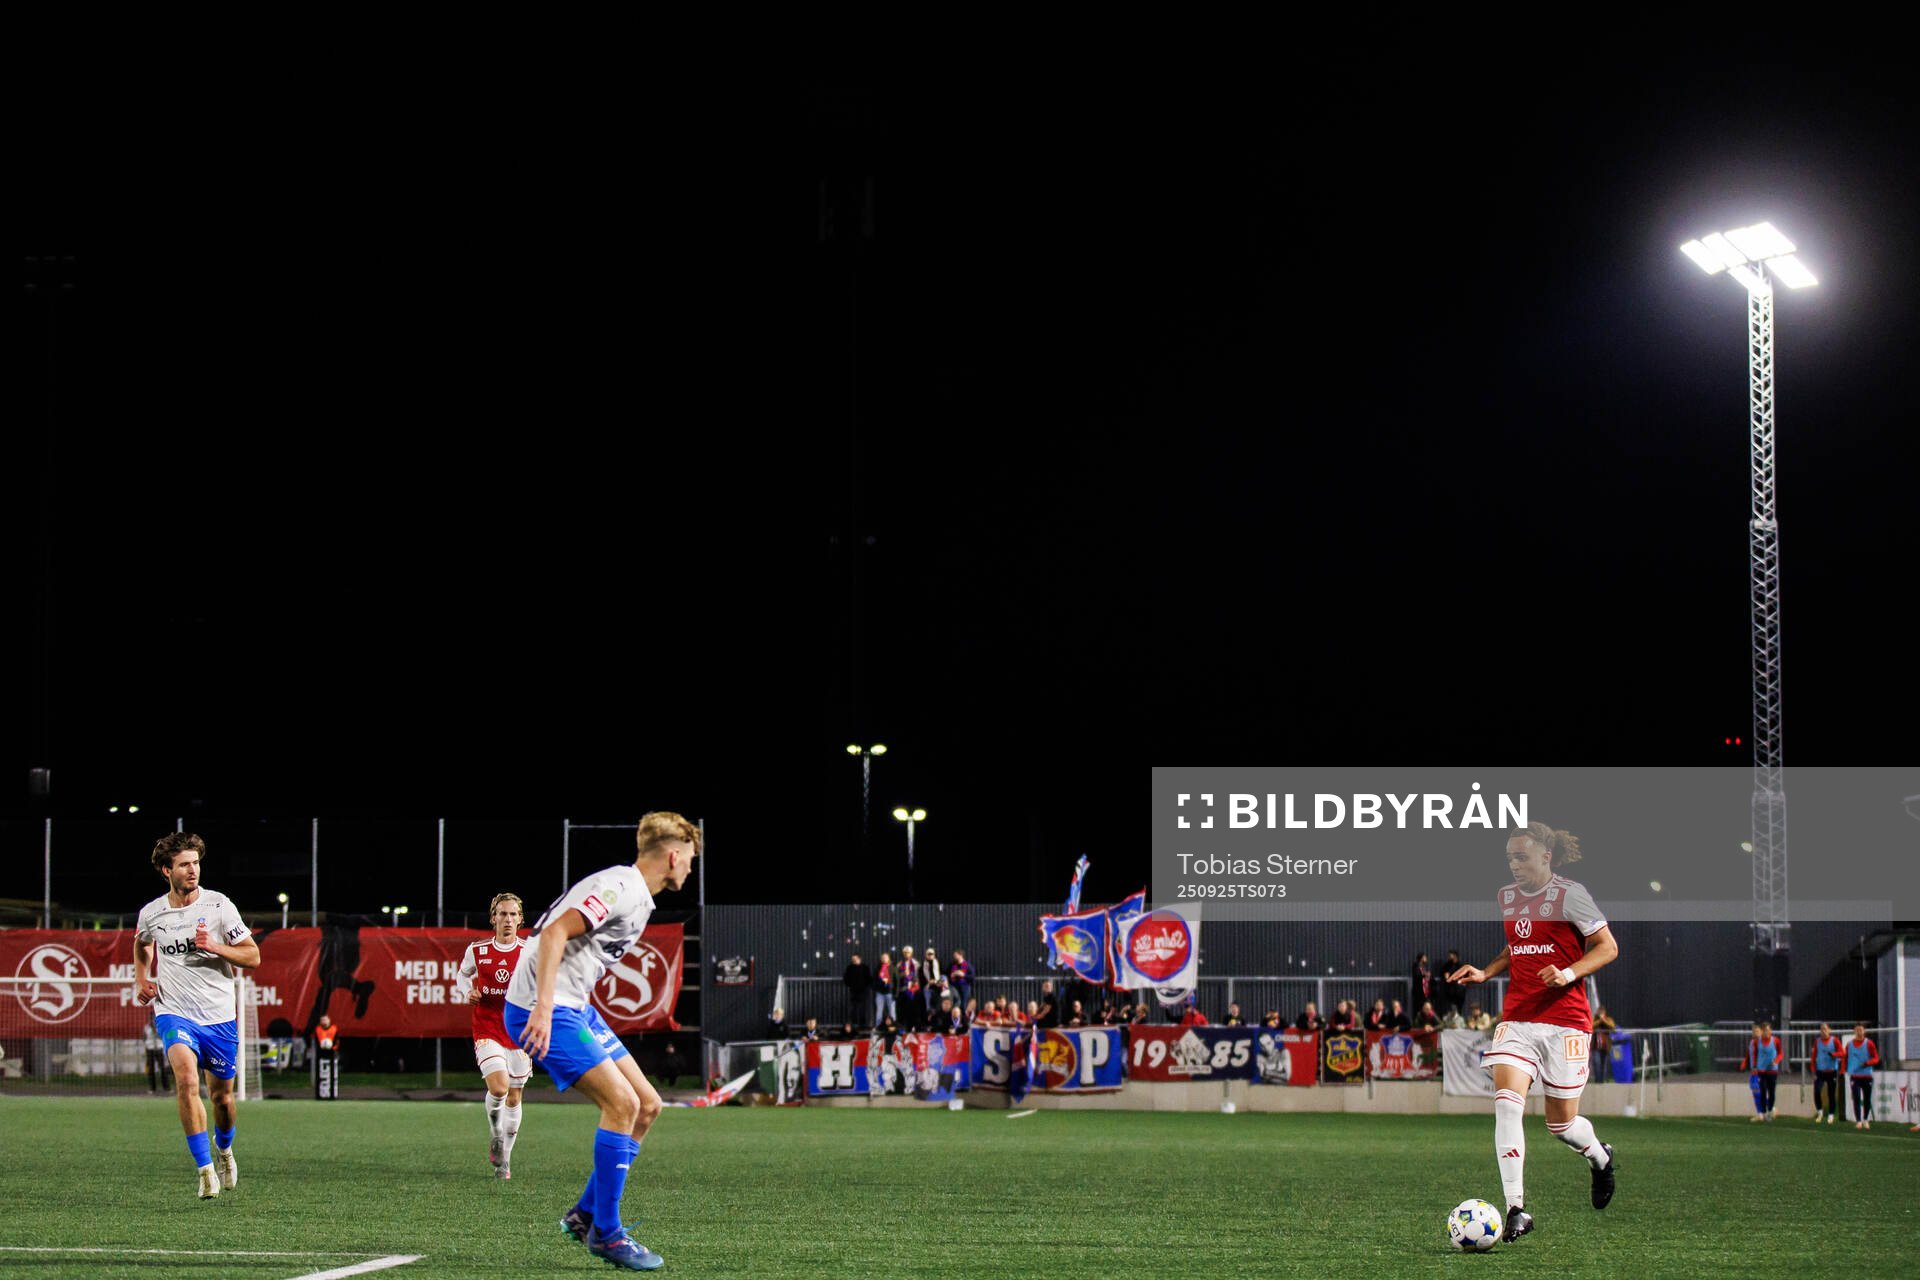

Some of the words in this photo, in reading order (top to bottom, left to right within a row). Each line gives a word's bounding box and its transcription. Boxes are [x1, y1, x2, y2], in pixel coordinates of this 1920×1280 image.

[1513, 943, 1555, 955] SANDVIK
[395, 960, 438, 980] MED
[407, 981, 446, 1004] FÖR
[1133, 1039, 1166, 1068] 19
[1211, 1040, 1251, 1068] 85
